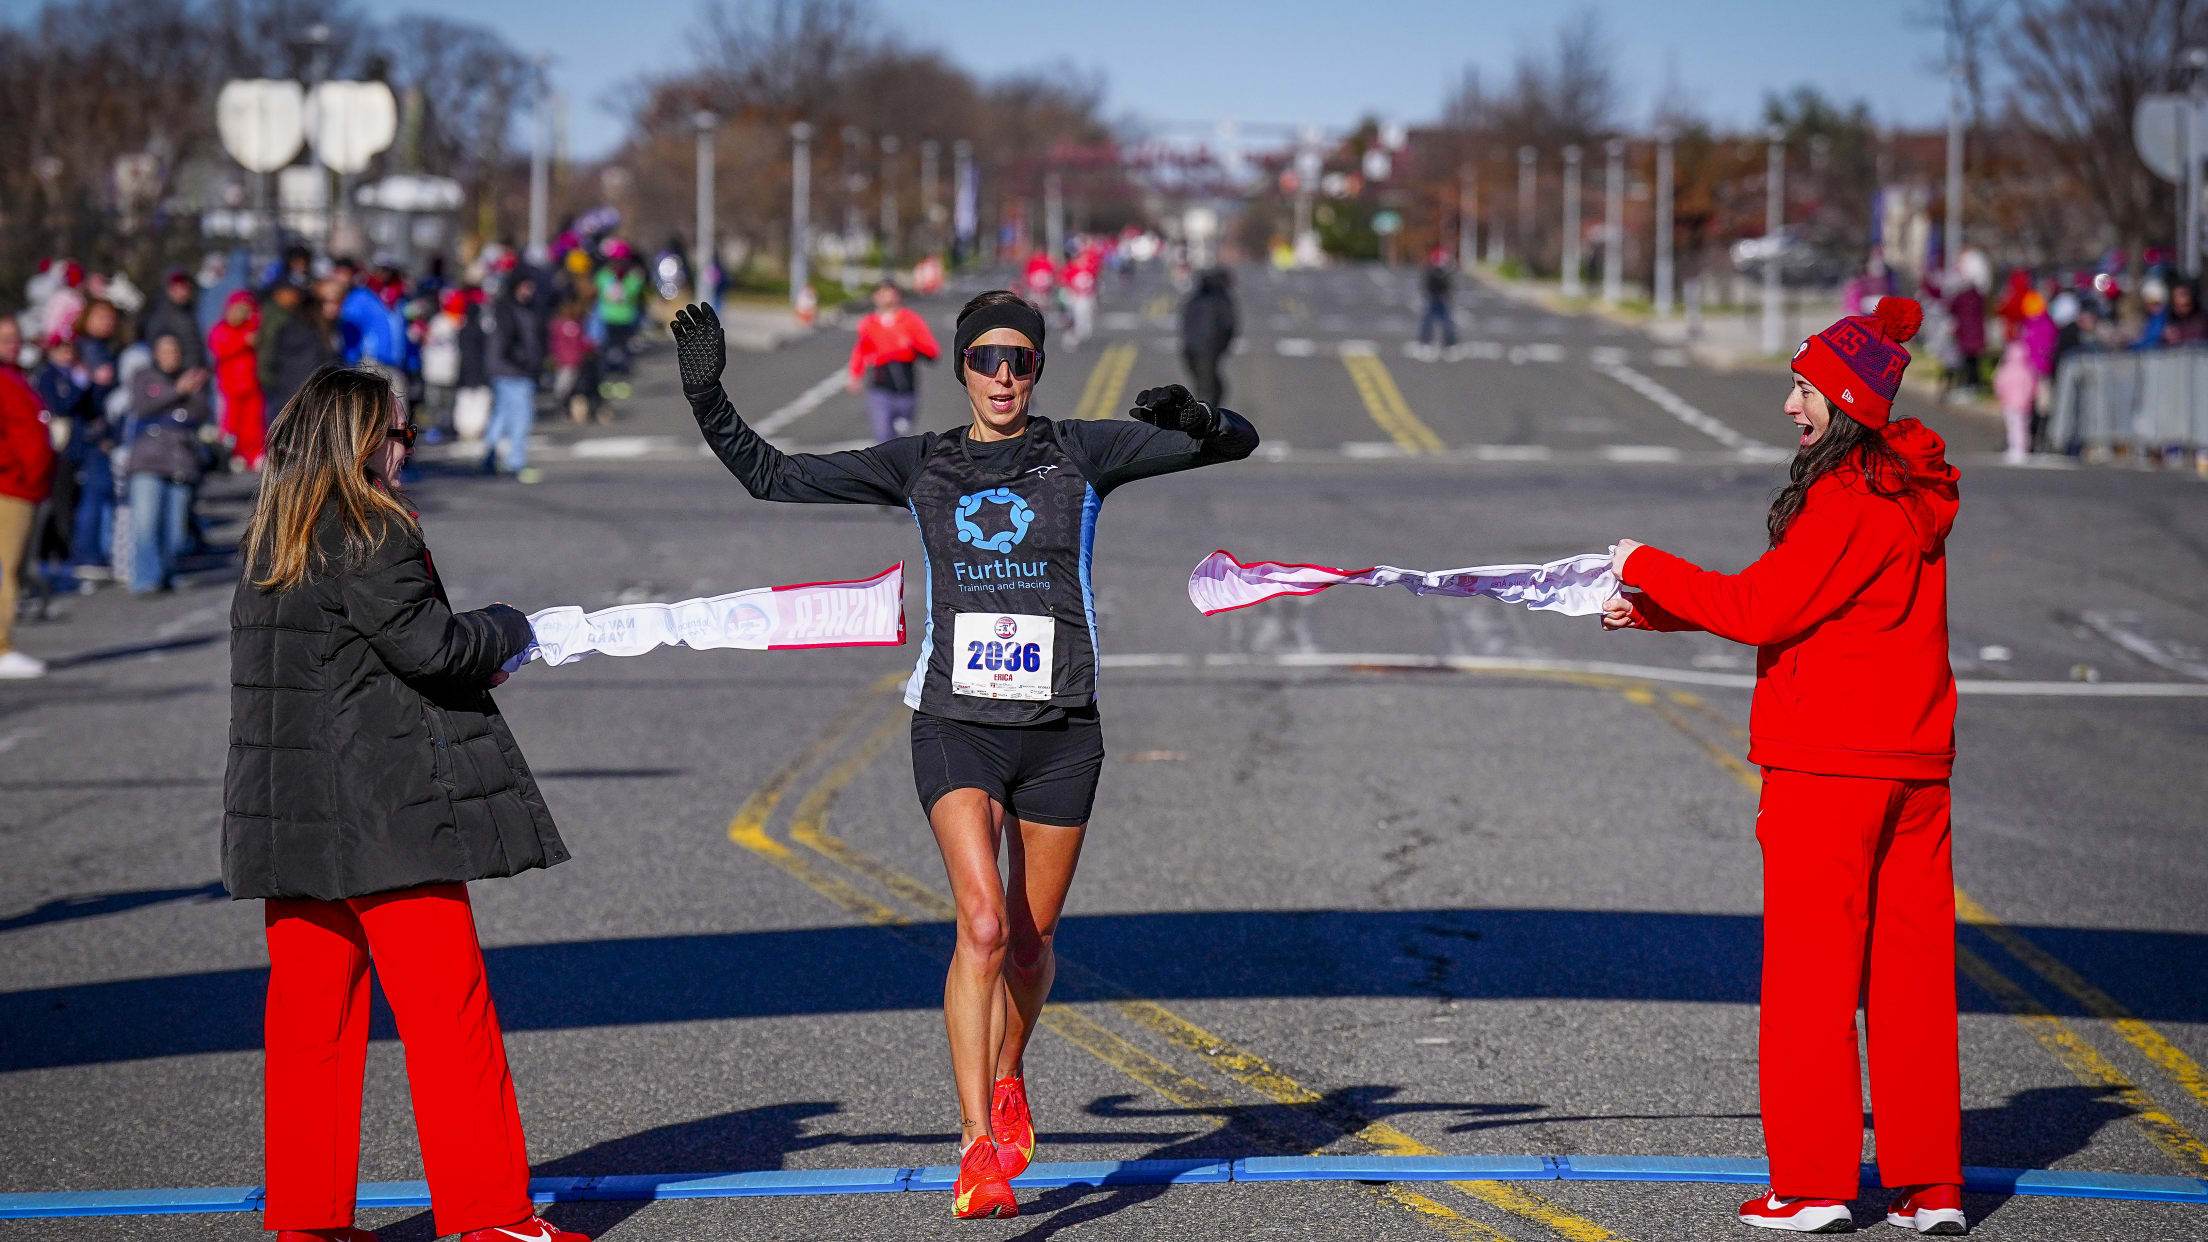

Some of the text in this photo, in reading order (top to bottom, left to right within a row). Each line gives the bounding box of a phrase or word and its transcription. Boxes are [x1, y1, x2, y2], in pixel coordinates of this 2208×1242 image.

[953, 558, 1048, 581] Furthur
[958, 580, 1051, 593] Training and Racing
[967, 640, 1041, 672] 2036
[993, 673, 1013, 681] ERICA
